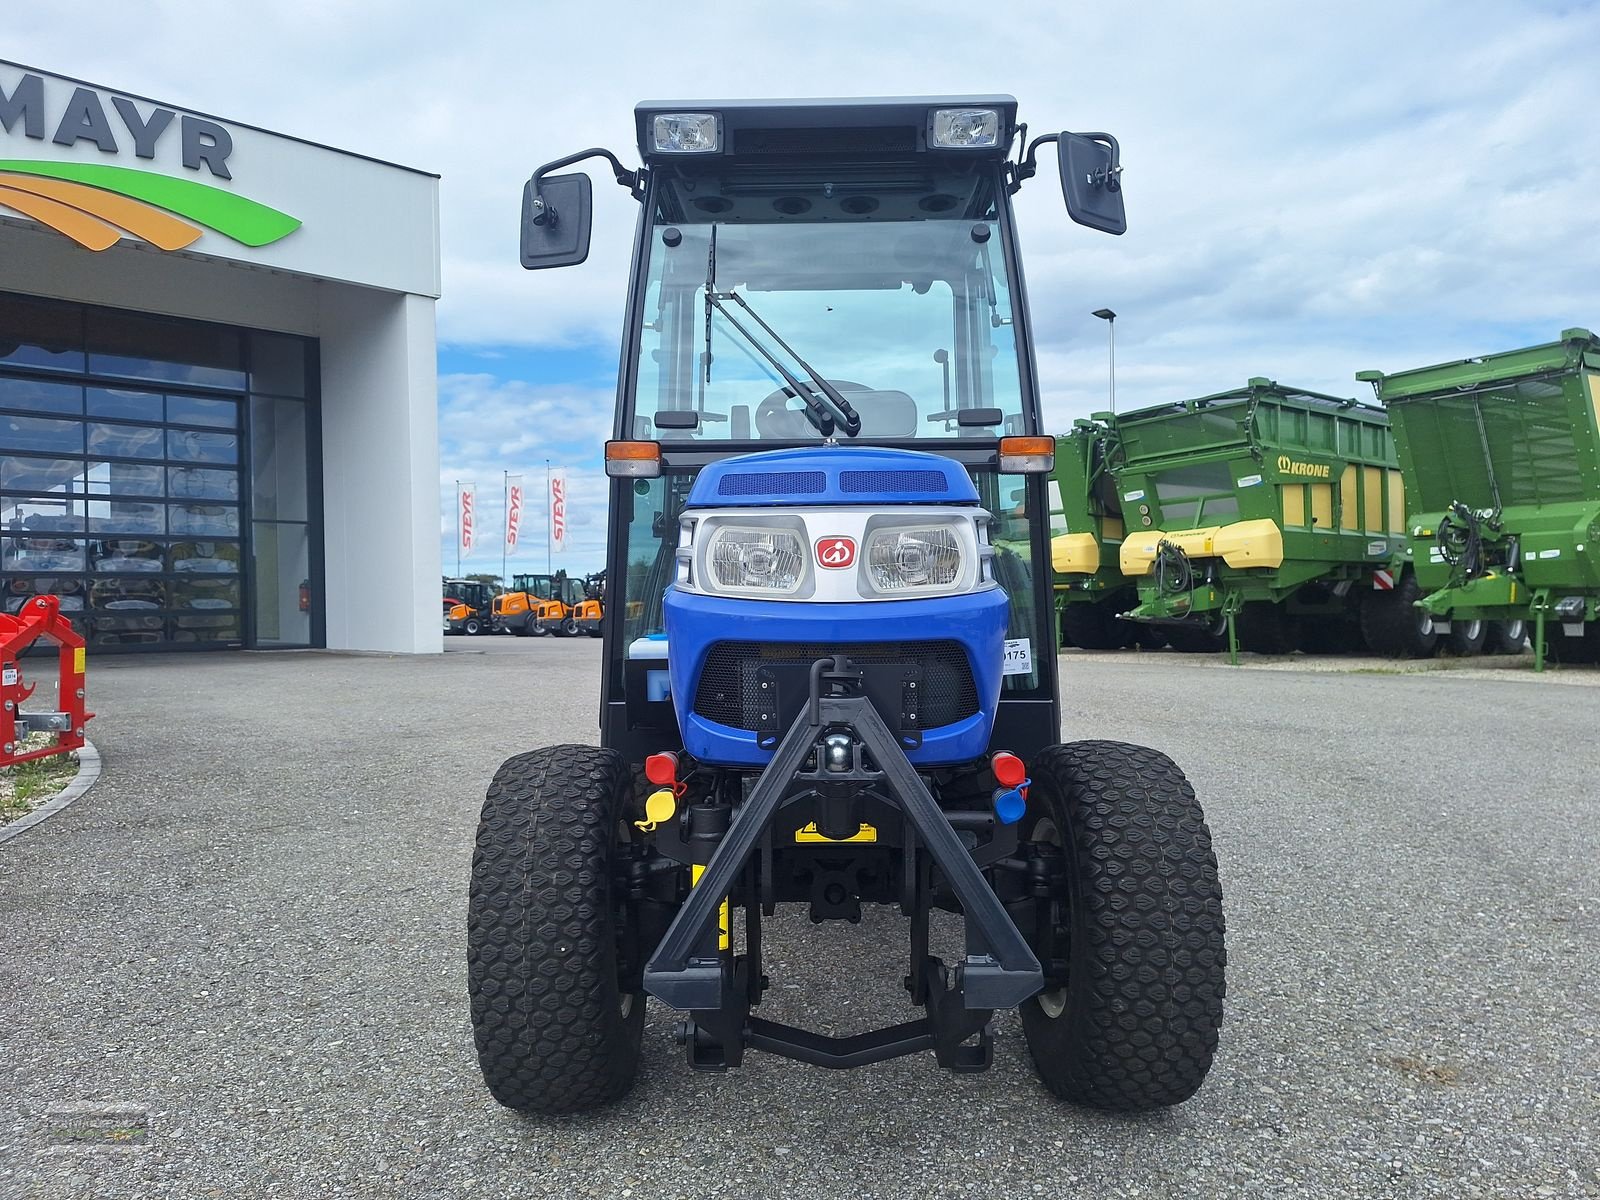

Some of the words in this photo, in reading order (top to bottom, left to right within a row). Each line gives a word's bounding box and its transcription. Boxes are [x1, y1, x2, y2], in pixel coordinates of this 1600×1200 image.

[0, 73, 233, 181] MAYR
[1291, 462, 1330, 478] KRONE
[462, 491, 472, 549] STEYR
[507, 486, 520, 545] STEYR
[552, 478, 564, 542] STEYR
